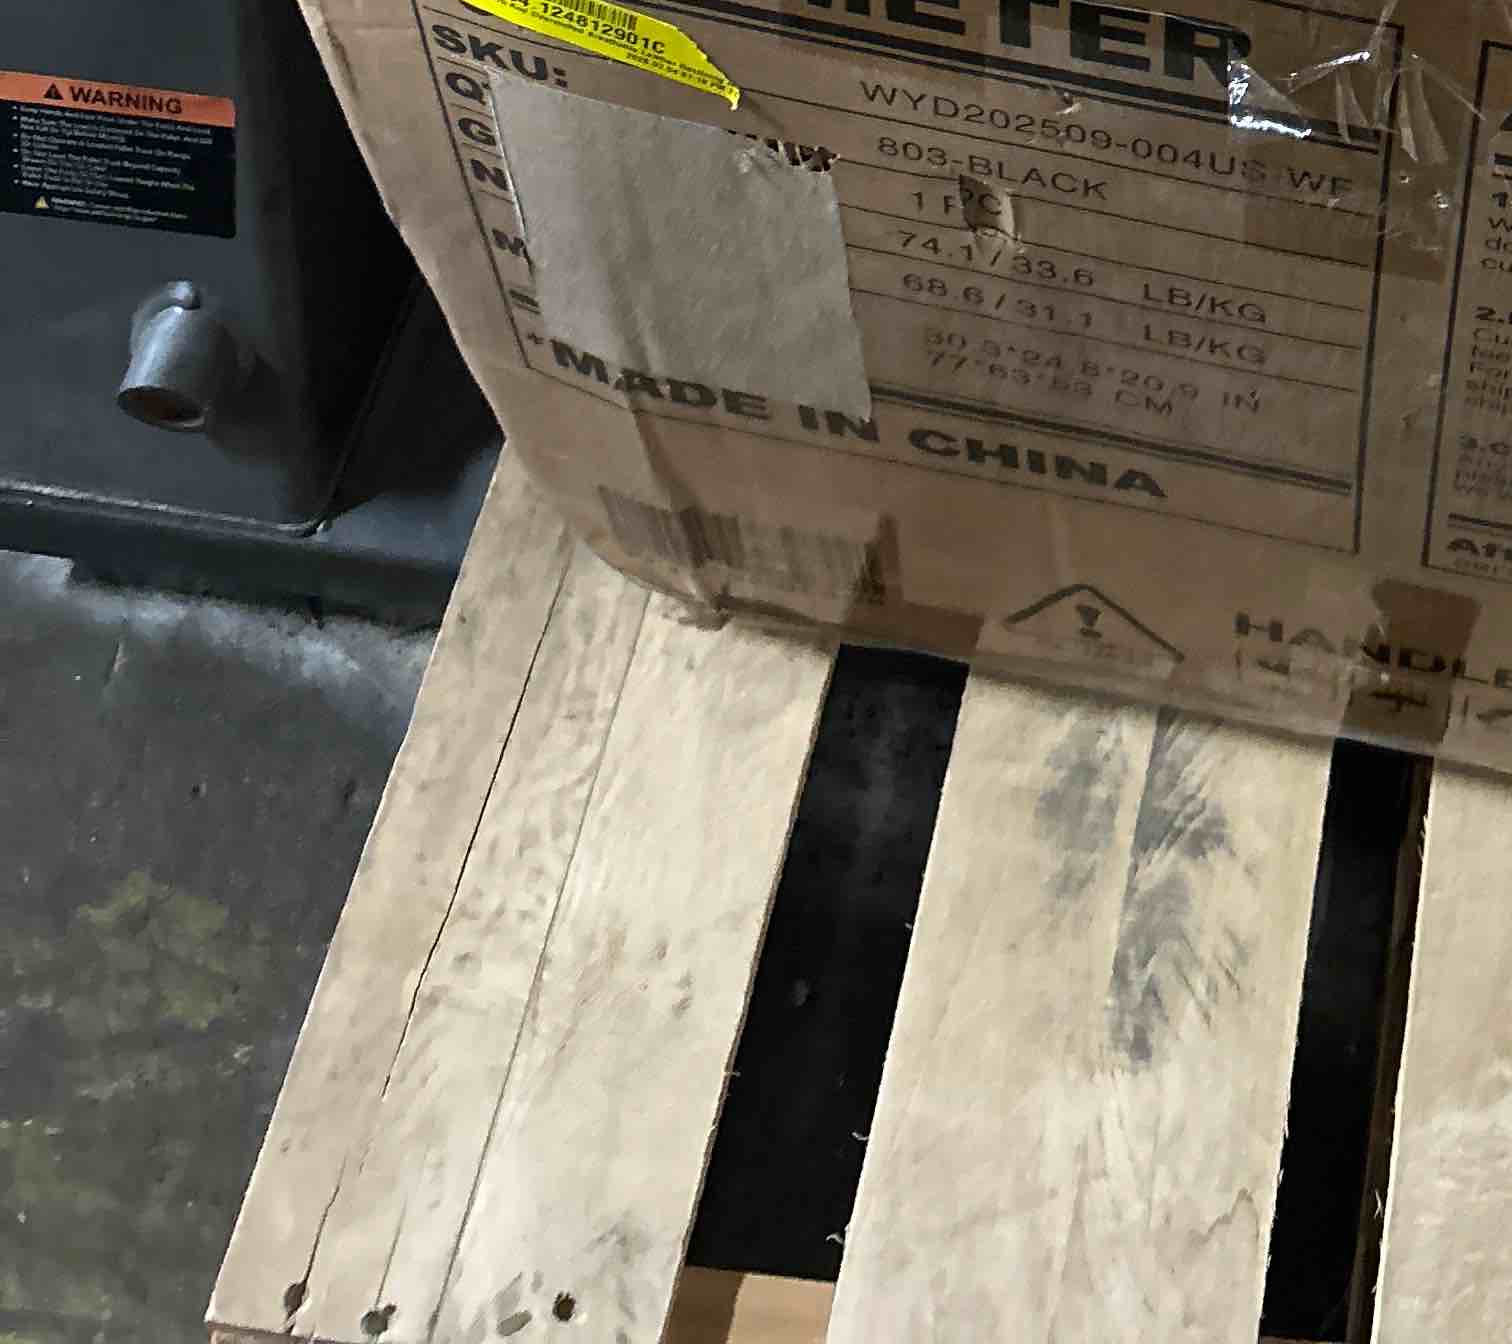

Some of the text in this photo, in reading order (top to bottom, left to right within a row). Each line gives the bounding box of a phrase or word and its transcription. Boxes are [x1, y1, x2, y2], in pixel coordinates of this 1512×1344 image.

[431, 24, 568, 88] SKU:
[69, 85, 182, 114] WARNING
[876, 135, 1111, 200] 803-BLACK
[1142, 283, 1269, 323] LB/KG
[1142, 324, 1269, 365] LB/KG
[550, 338, 1167, 500] MADE IN CHINA
